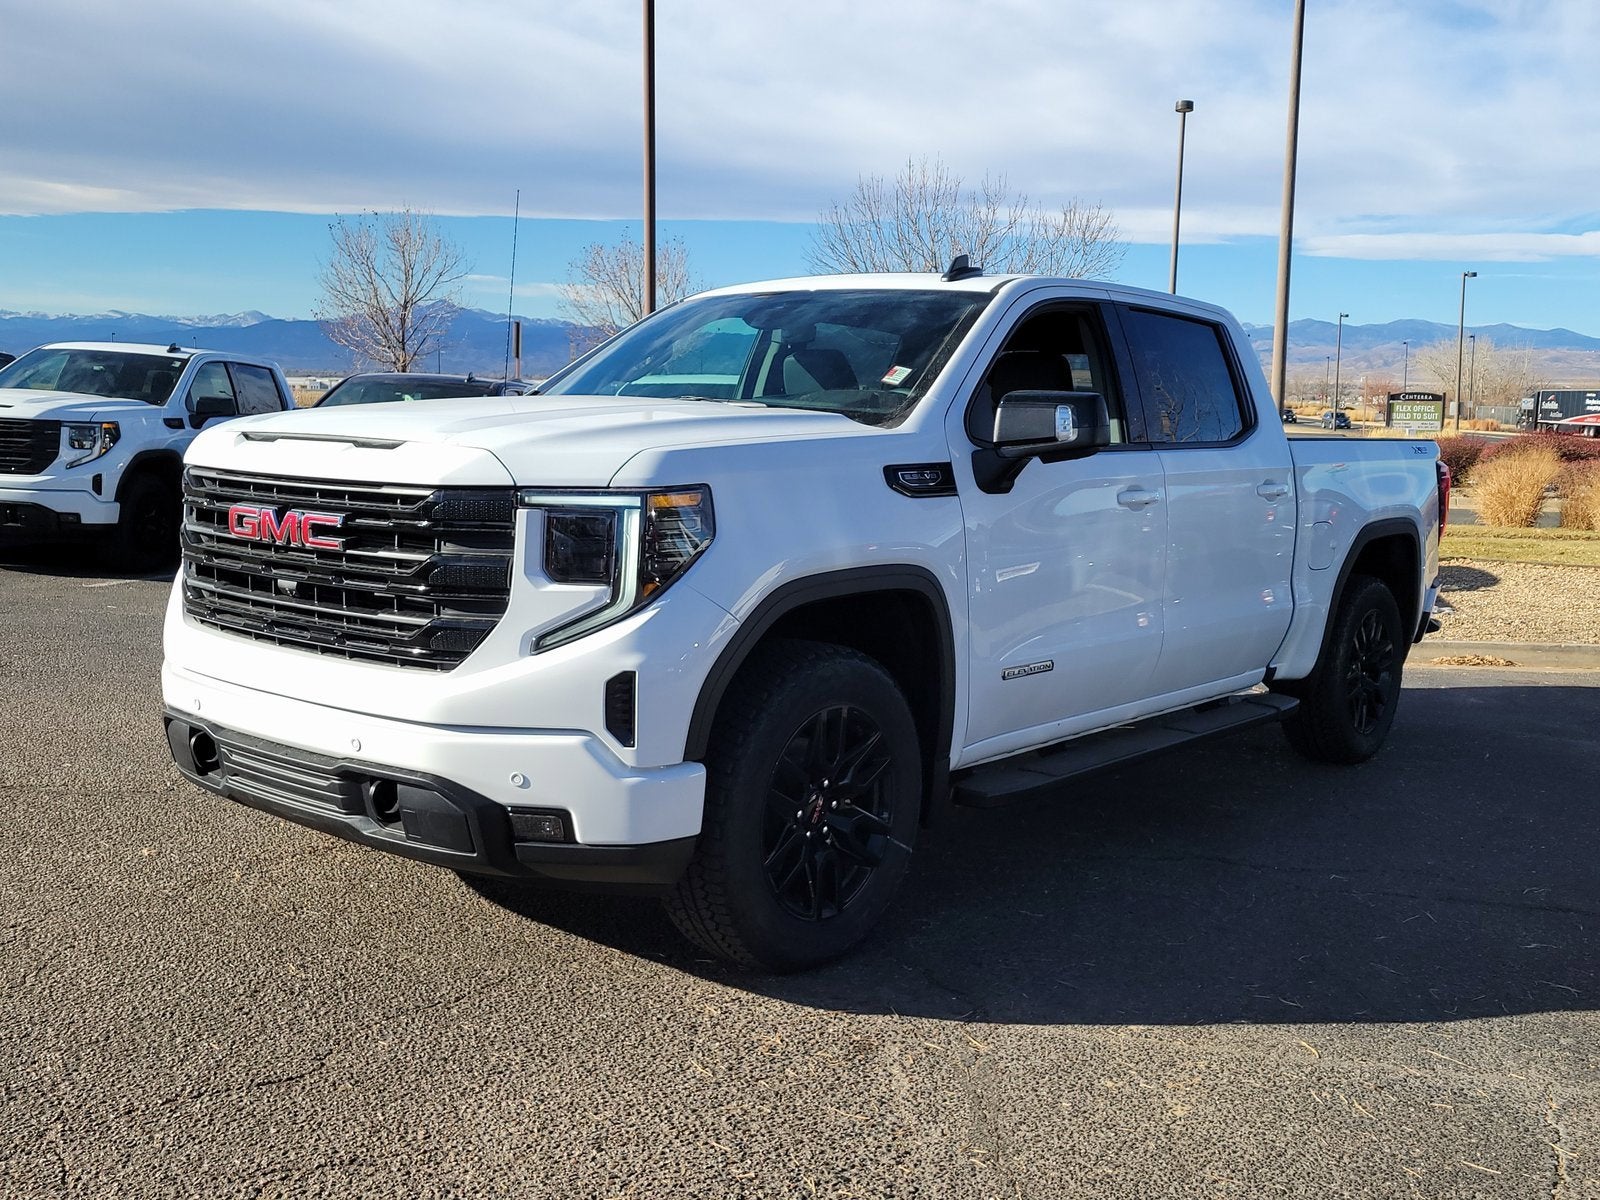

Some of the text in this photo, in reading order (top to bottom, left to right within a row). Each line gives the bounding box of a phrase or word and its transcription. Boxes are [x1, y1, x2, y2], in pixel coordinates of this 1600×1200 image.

[1396, 404, 1412, 412] FLEX
[1392, 412, 1411, 420] BUILD
[1413, 412, 1422, 420] TO
[228, 503, 345, 551] GMC
[1006, 663, 1051, 677] ELEVATION
